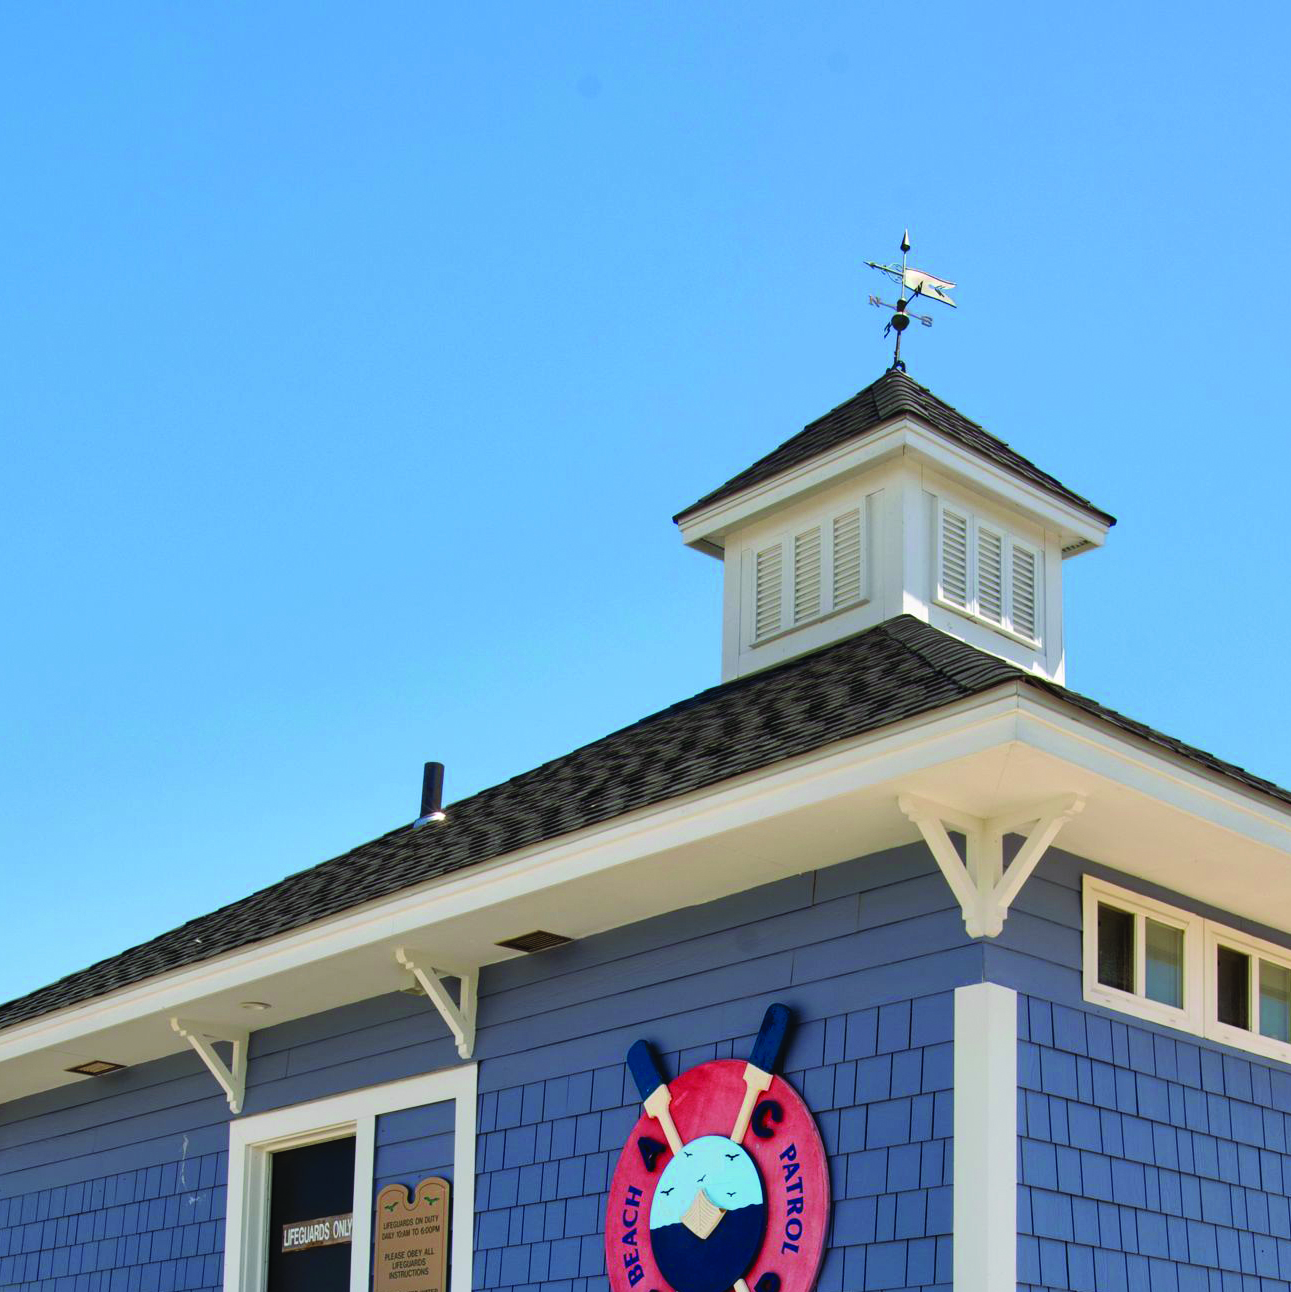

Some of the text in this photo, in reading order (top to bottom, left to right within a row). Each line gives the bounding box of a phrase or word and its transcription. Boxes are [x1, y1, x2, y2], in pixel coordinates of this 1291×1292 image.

[638, 1100, 784, 1173] A C
[383, 1215, 439, 1230] LIFEGUARDS ON DUTY
[622, 1143, 803, 1288] BEACH PATROL
[284, 1219, 353, 1247] LIFEGUARDS ONLY
[382, 1232, 395, 1241] DAILY
[412, 1227, 420, 1236] TO
[385, 1247, 434, 1261] PLEASE OBEY ALL
[392, 1258, 426, 1270] LIFEGUARDS
[389, 1267, 429, 1279] INSTRUCTIONS
